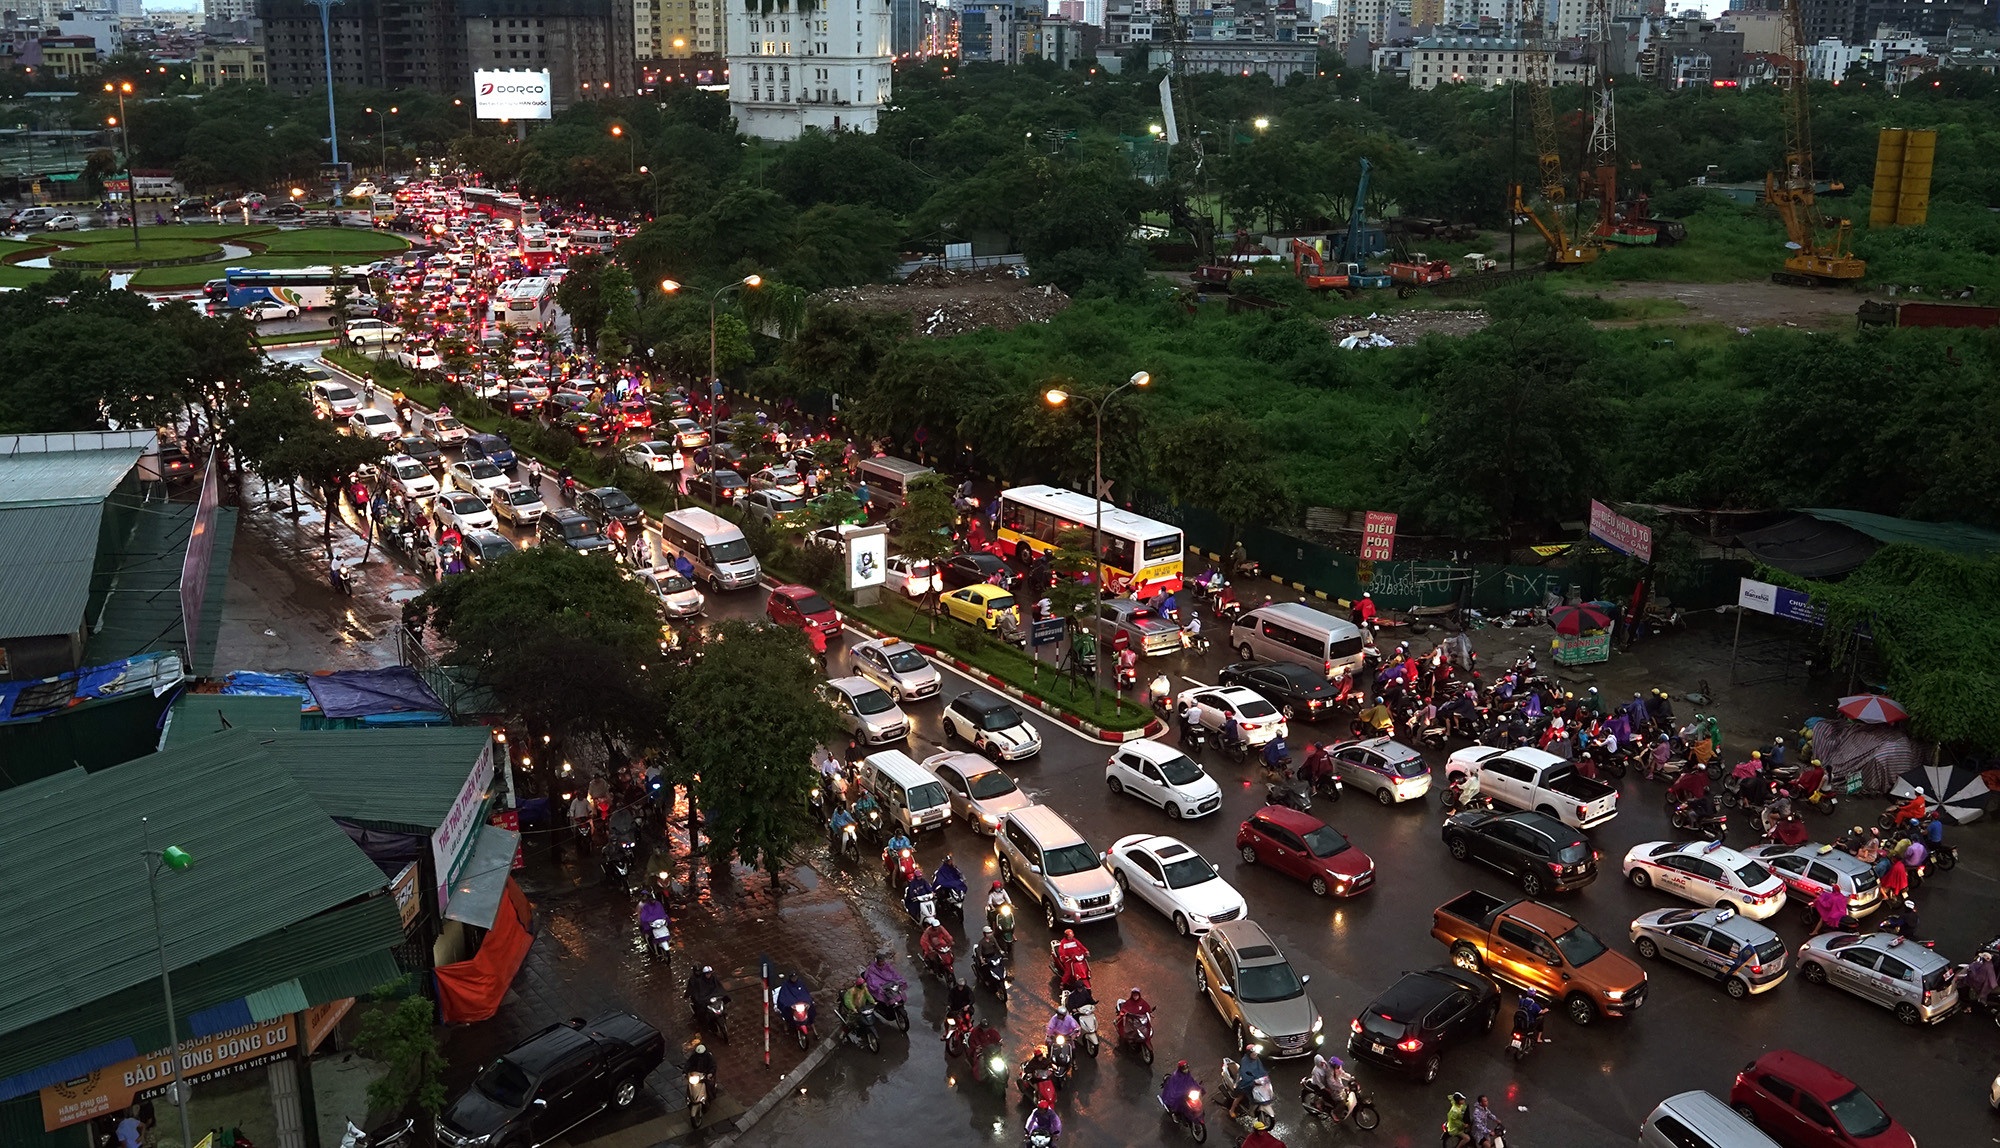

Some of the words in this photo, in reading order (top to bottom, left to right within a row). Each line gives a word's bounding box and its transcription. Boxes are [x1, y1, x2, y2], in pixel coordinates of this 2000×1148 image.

[497, 86, 544, 94] DORCO
[1364, 547, 1372, 558] Ô
[1375, 549, 1389, 560] TÔ
[1671, 877, 1686, 885] JAC
[124, 1064, 157, 1087] BẢO
[217, 1034, 261, 1059] ĐỘNG
[266, 1026, 287, 1046] CƠ
[201, 1073, 212, 1082] CÓ
[234, 1062, 247, 1072] TẠI
[250, 1057, 267, 1067] VIỆT
[270, 1051, 287, 1061] NAM
